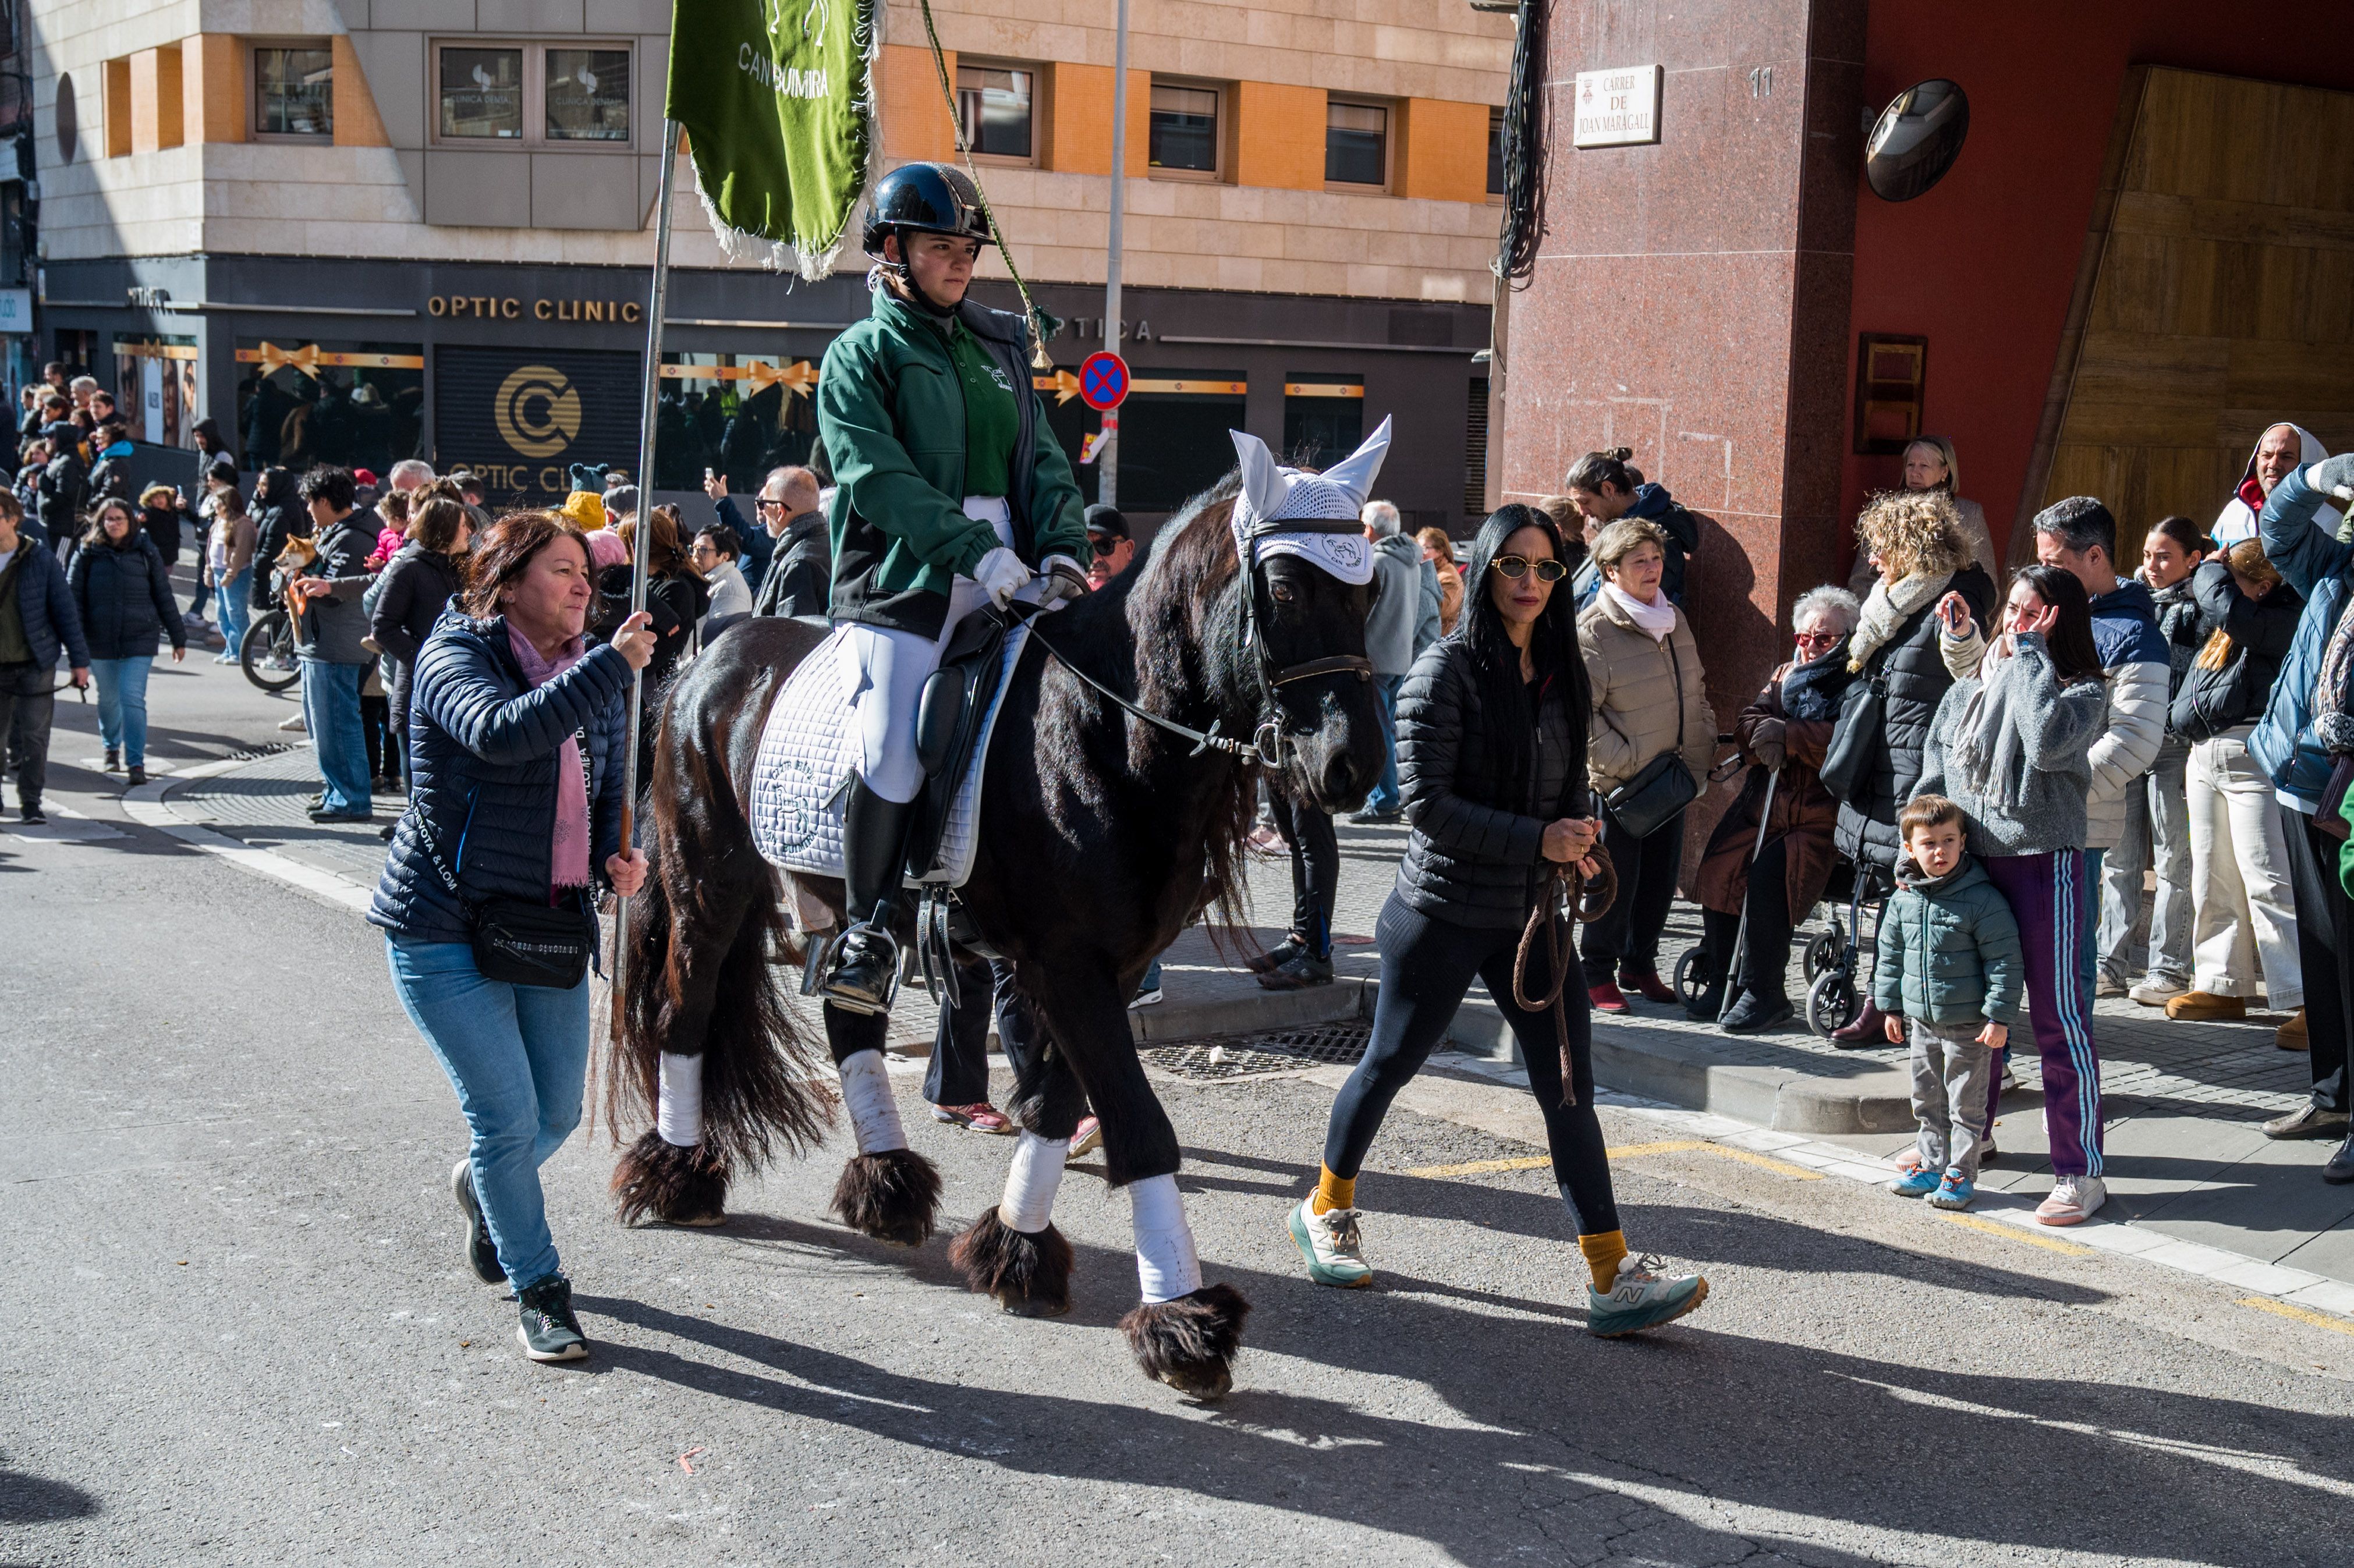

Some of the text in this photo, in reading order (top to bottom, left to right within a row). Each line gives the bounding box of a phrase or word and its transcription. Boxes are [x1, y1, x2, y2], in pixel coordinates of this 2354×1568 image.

[739, 42, 770, 87] CAN
[1604, 76, 1635, 91] CARRER
[1749, 67, 1772, 100] 11
[484, 95, 512, 104] DENTAL
[591, 97, 618, 107] DENTAL
[1611, 96, 1627, 110] DE
[1579, 113, 1649, 139] JOAN MARAGALL
[428, 295, 641, 322] OPTIC CLINIC
[414, 806, 458, 891] DEVOTA & LOM
[588, 865, 597, 901] OMBA
[1614, 1286, 1645, 1304] N
